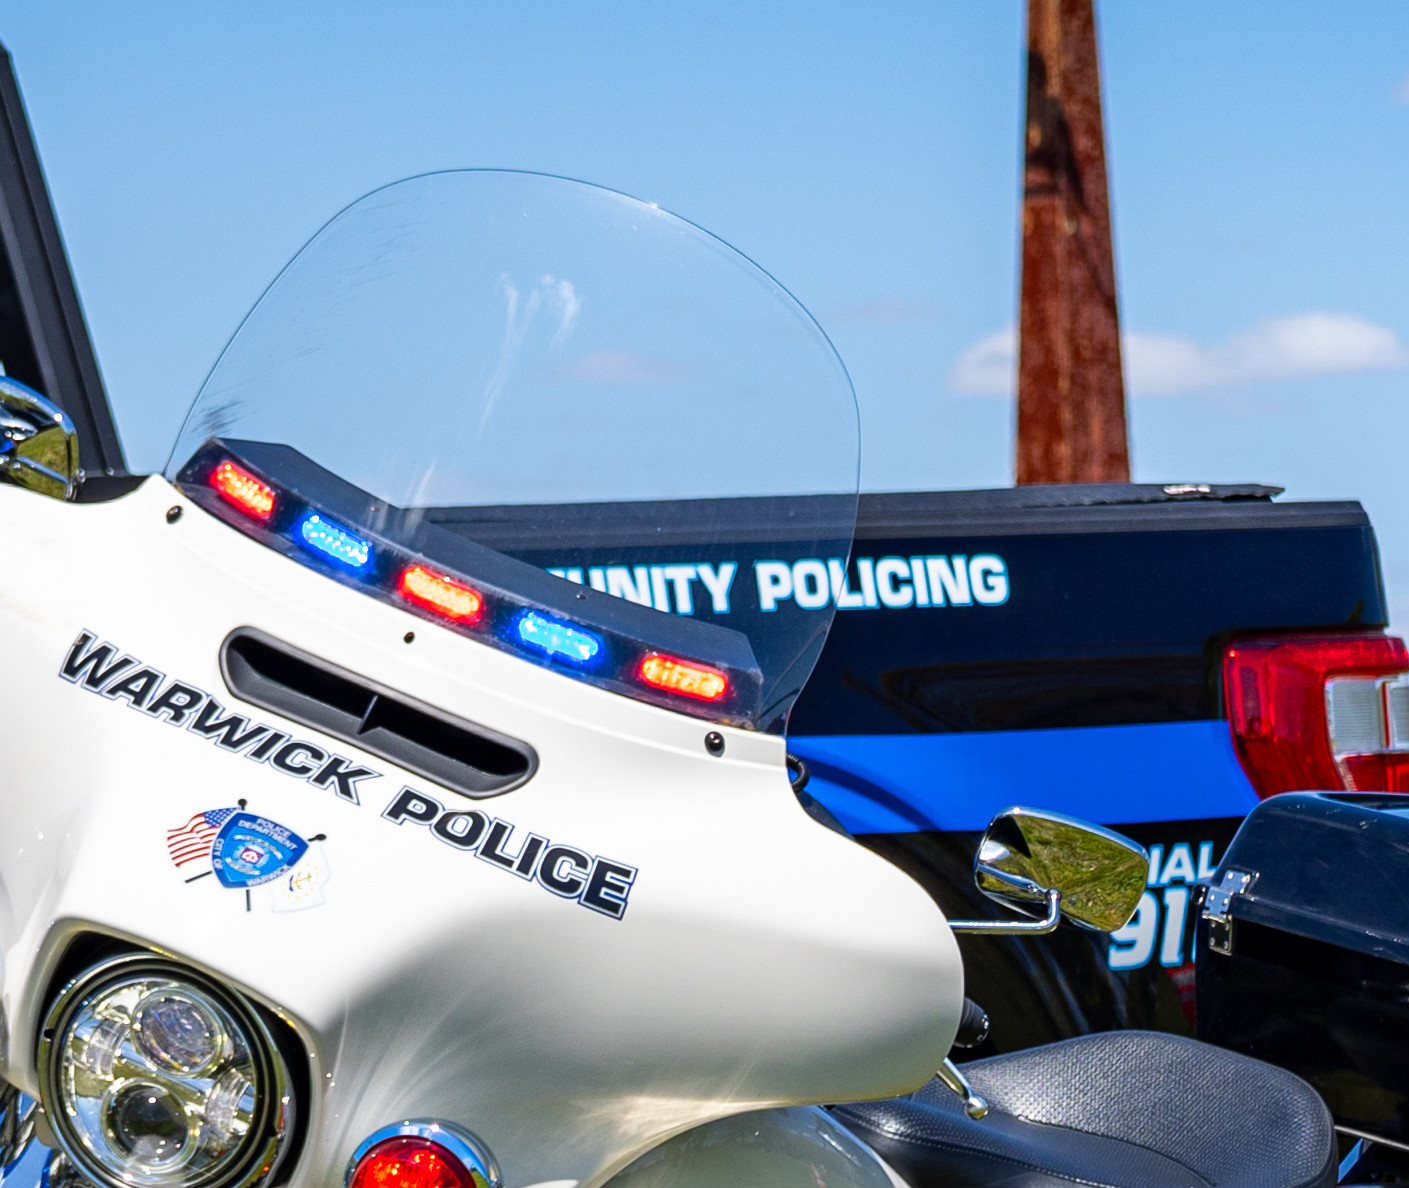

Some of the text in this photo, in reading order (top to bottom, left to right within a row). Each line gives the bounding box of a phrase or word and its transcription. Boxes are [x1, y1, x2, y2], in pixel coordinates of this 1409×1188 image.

[754, 553, 1011, 613] POLICING
[58, 628, 640, 920] WARWICK POLICE
[238, 820, 298, 850] DEPARTMENT
[256, 818, 292, 838] POLICE
[213, 838, 224, 857] CITY
[246, 864, 291, 886] WARWICK
[1108, 885, 1196, 970] 91
